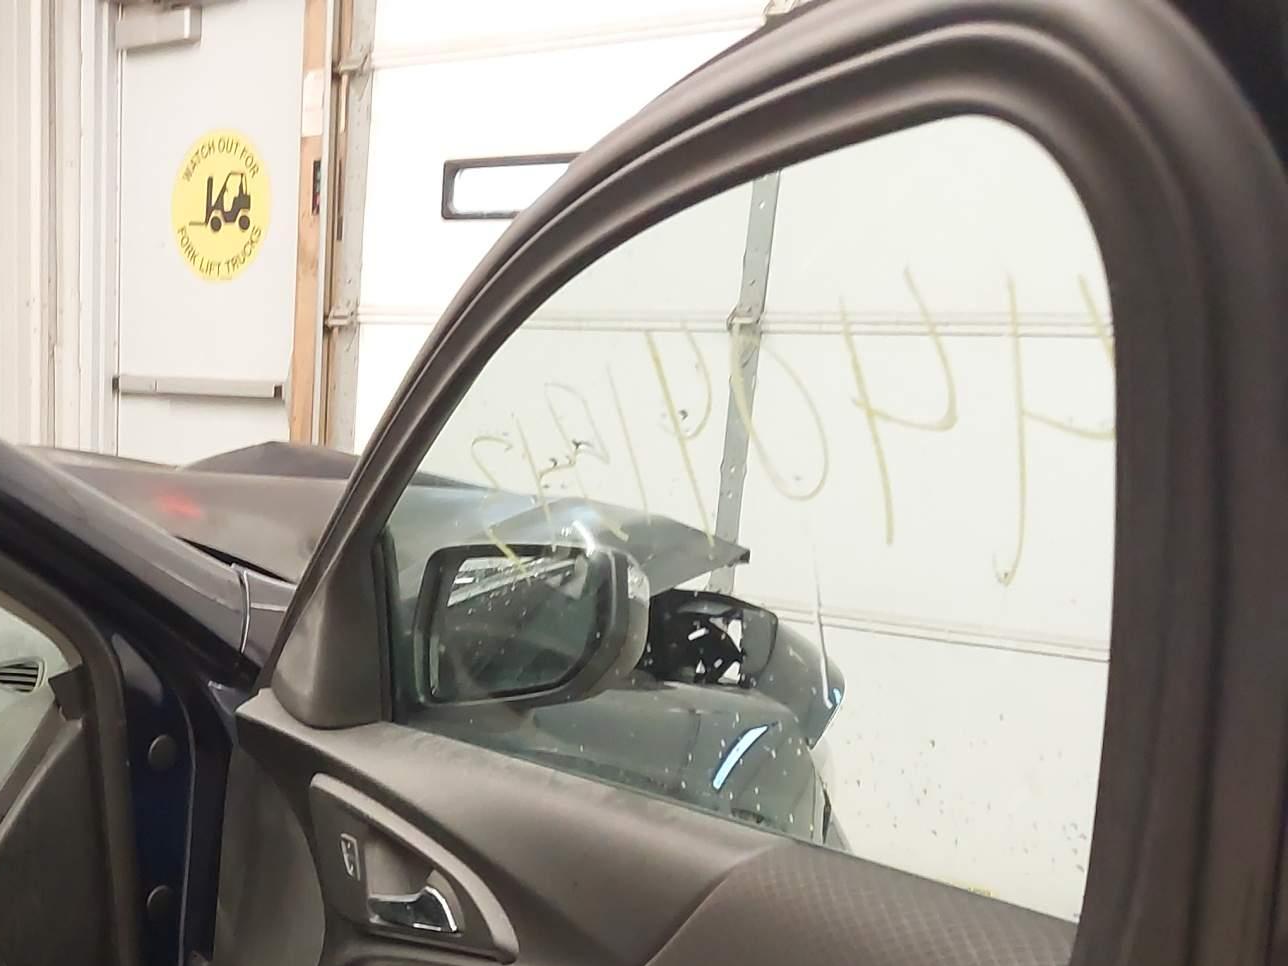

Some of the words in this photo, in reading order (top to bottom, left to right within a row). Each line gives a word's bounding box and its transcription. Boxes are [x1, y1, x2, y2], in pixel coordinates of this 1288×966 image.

[182, 138, 215, 182] WATCH
[217, 136, 240, 156] OUT
[239, 145, 260, 179] FOR
[177, 226, 199, 268] FORK
[198, 255, 222, 277] LIFT
[225, 224, 262, 274] TRUCKS
